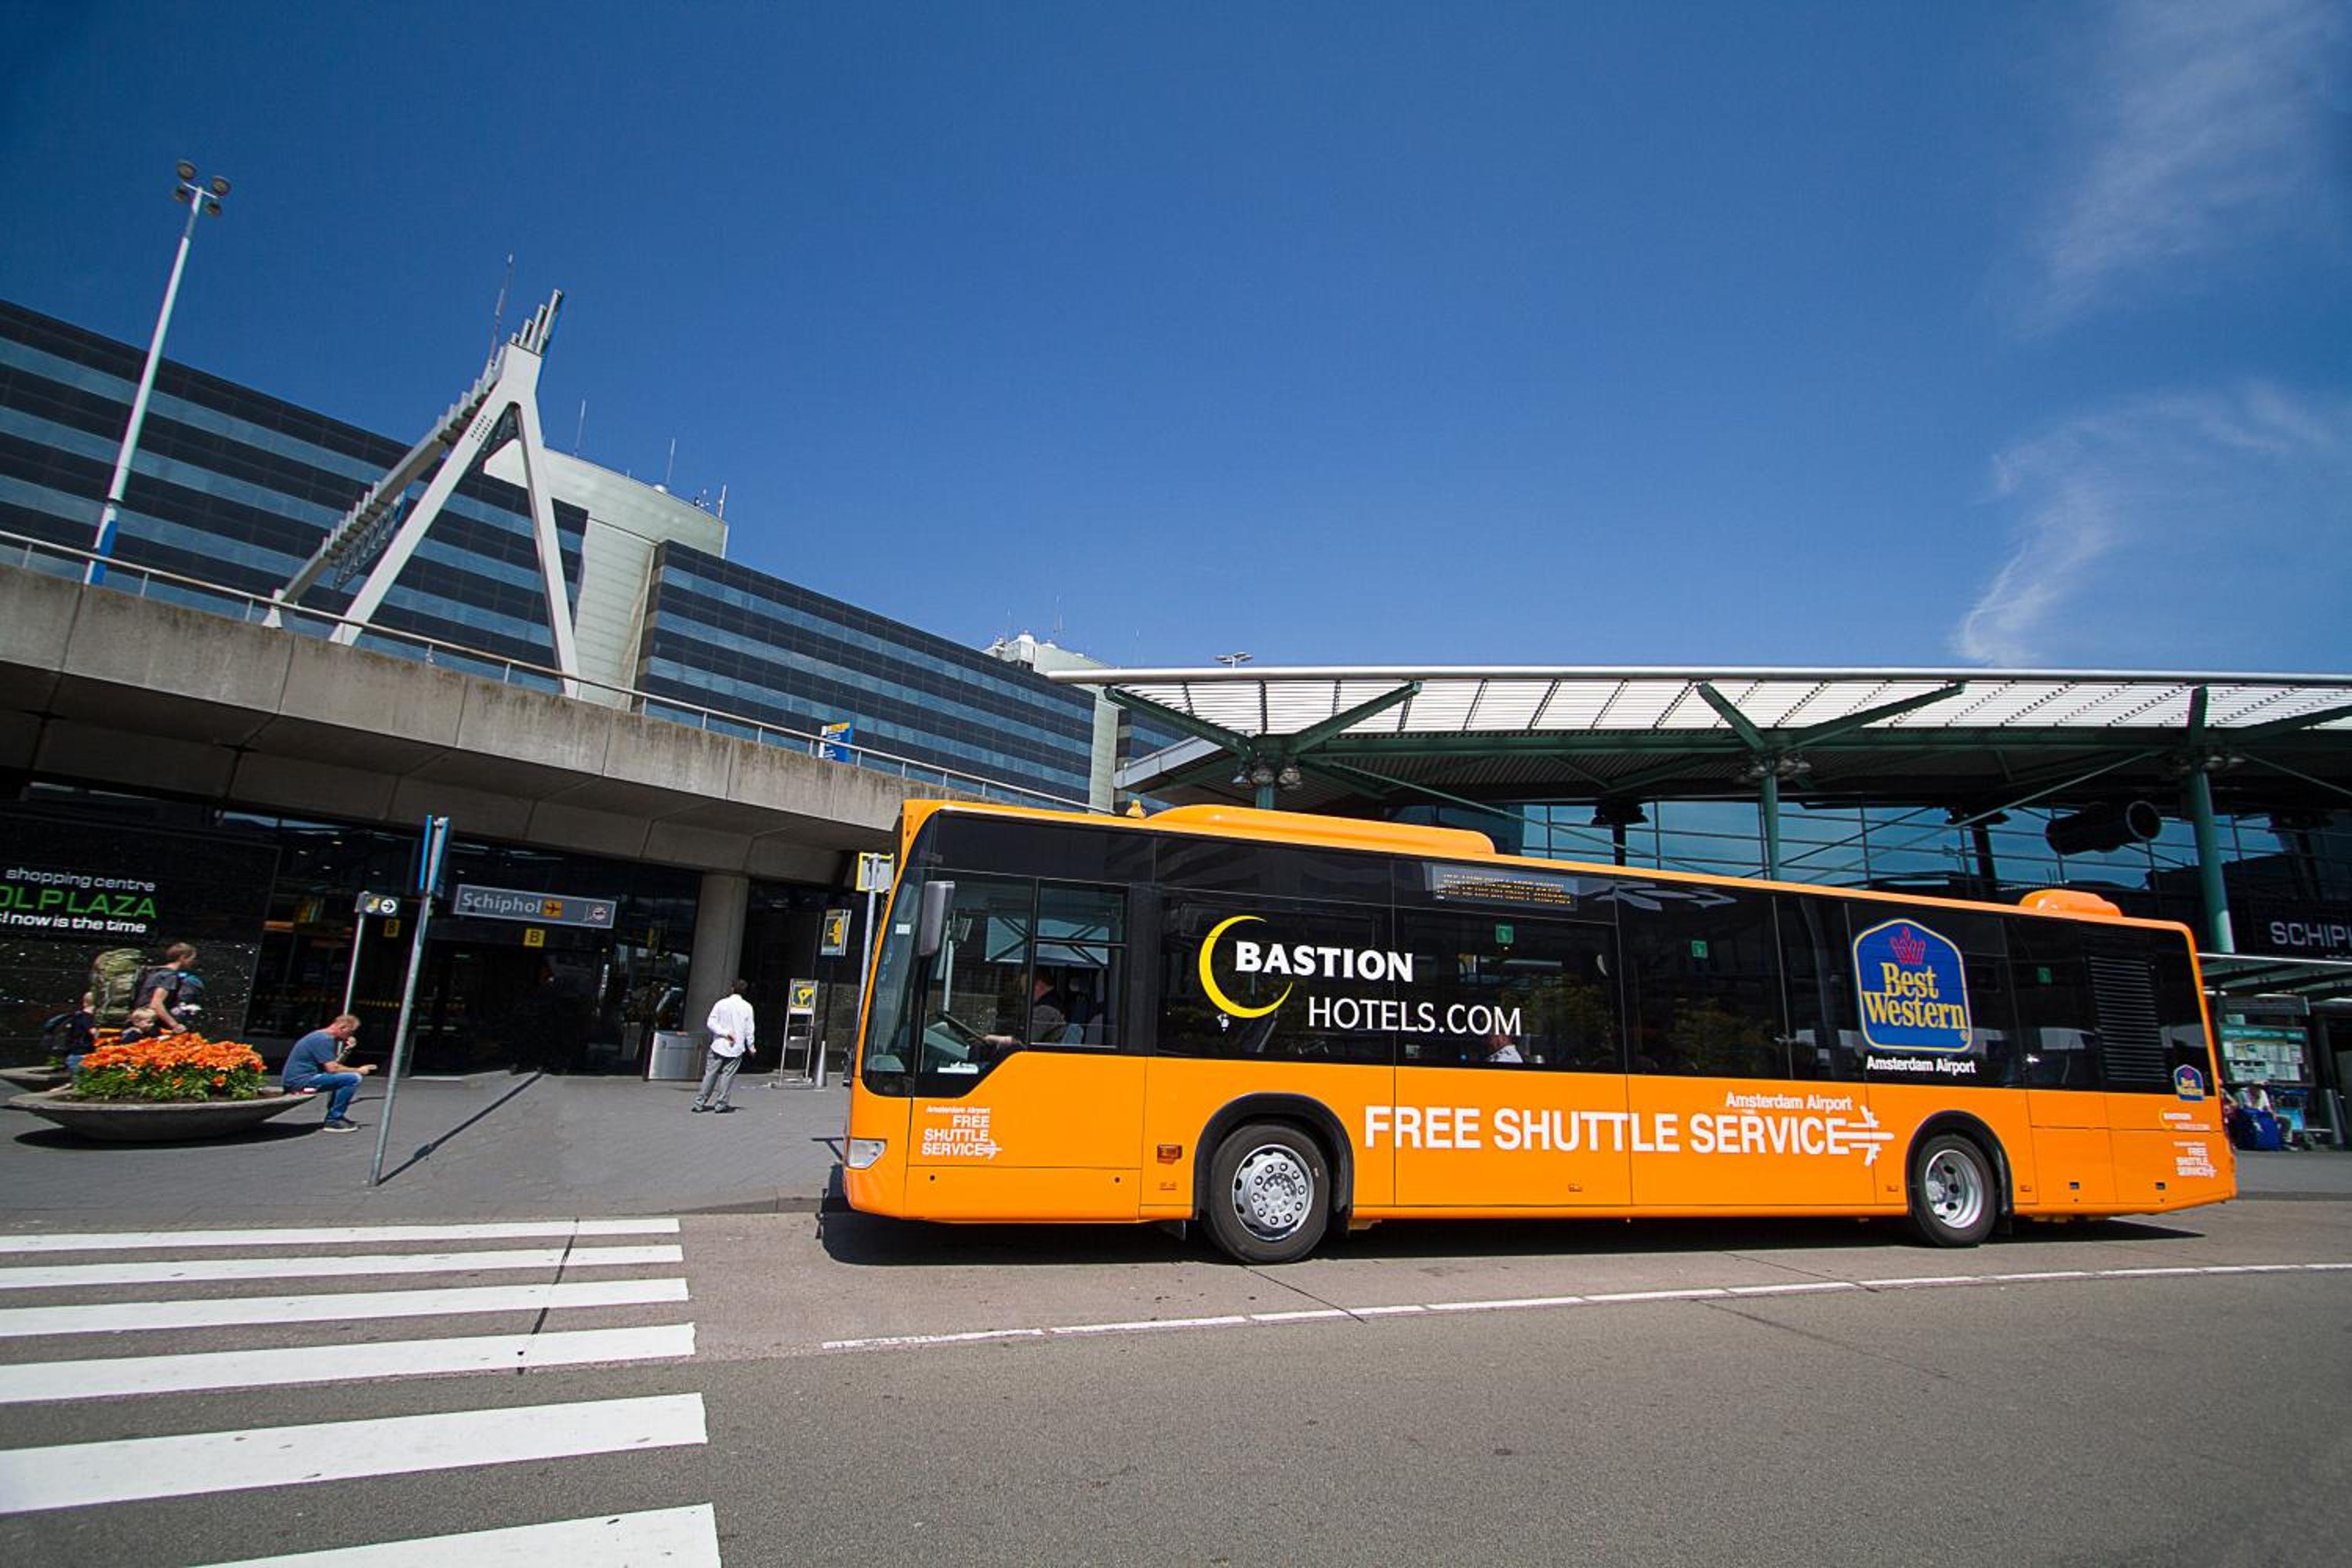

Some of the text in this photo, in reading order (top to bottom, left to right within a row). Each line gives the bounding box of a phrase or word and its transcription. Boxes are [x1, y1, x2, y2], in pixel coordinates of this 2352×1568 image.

[5, 867, 156, 892] shopping centre
[462, 892, 542, 915] Schiphol
[10, 913, 52, 927] now
[53, 914, 69, 928] is
[72, 916, 103, 931] the
[106, 920, 147, 933] time
[528, 931, 541, 943] B
[2270, 921, 2352, 949] SCHIP
[1234, 940, 1414, 982] BASTION
[1880, 962, 1940, 999] Best
[1308, 996, 1522, 1036] HOTELS.COM
[1863, 991, 1968, 1029] Western
[1867, 1055, 1976, 1076] Amsterdam Airport
[1726, 1091, 1853, 1113] Amsterdam Airport
[953, 1115, 990, 1128] FREE
[1364, 1105, 1850, 1155] FREE SHUTTLE SERVICE
[924, 1128, 989, 1142] SHUTTLE
[921, 1142, 984, 1156] SERVICE
